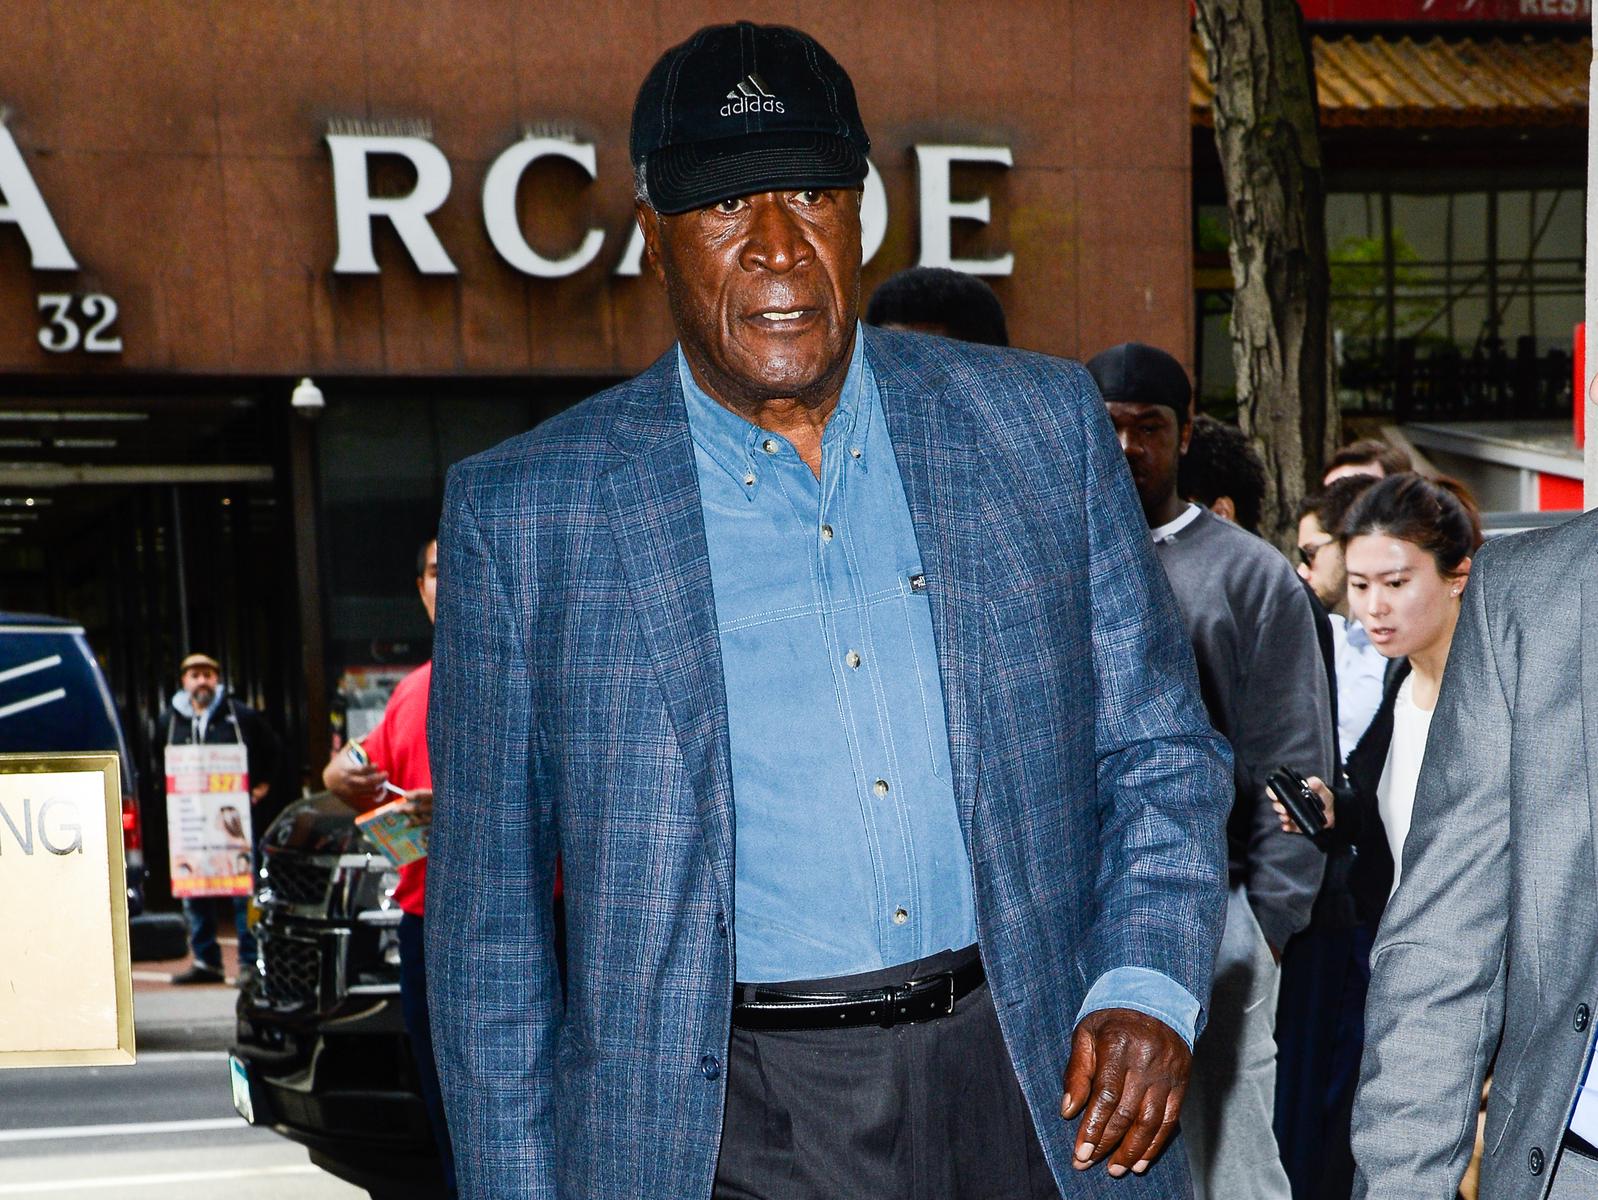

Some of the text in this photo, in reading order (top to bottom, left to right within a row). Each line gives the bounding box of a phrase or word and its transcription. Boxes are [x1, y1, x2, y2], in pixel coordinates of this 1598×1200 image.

[720, 95, 785, 116] adidas
[326, 134, 1014, 278] RCE
[37, 294, 123, 353] 32
